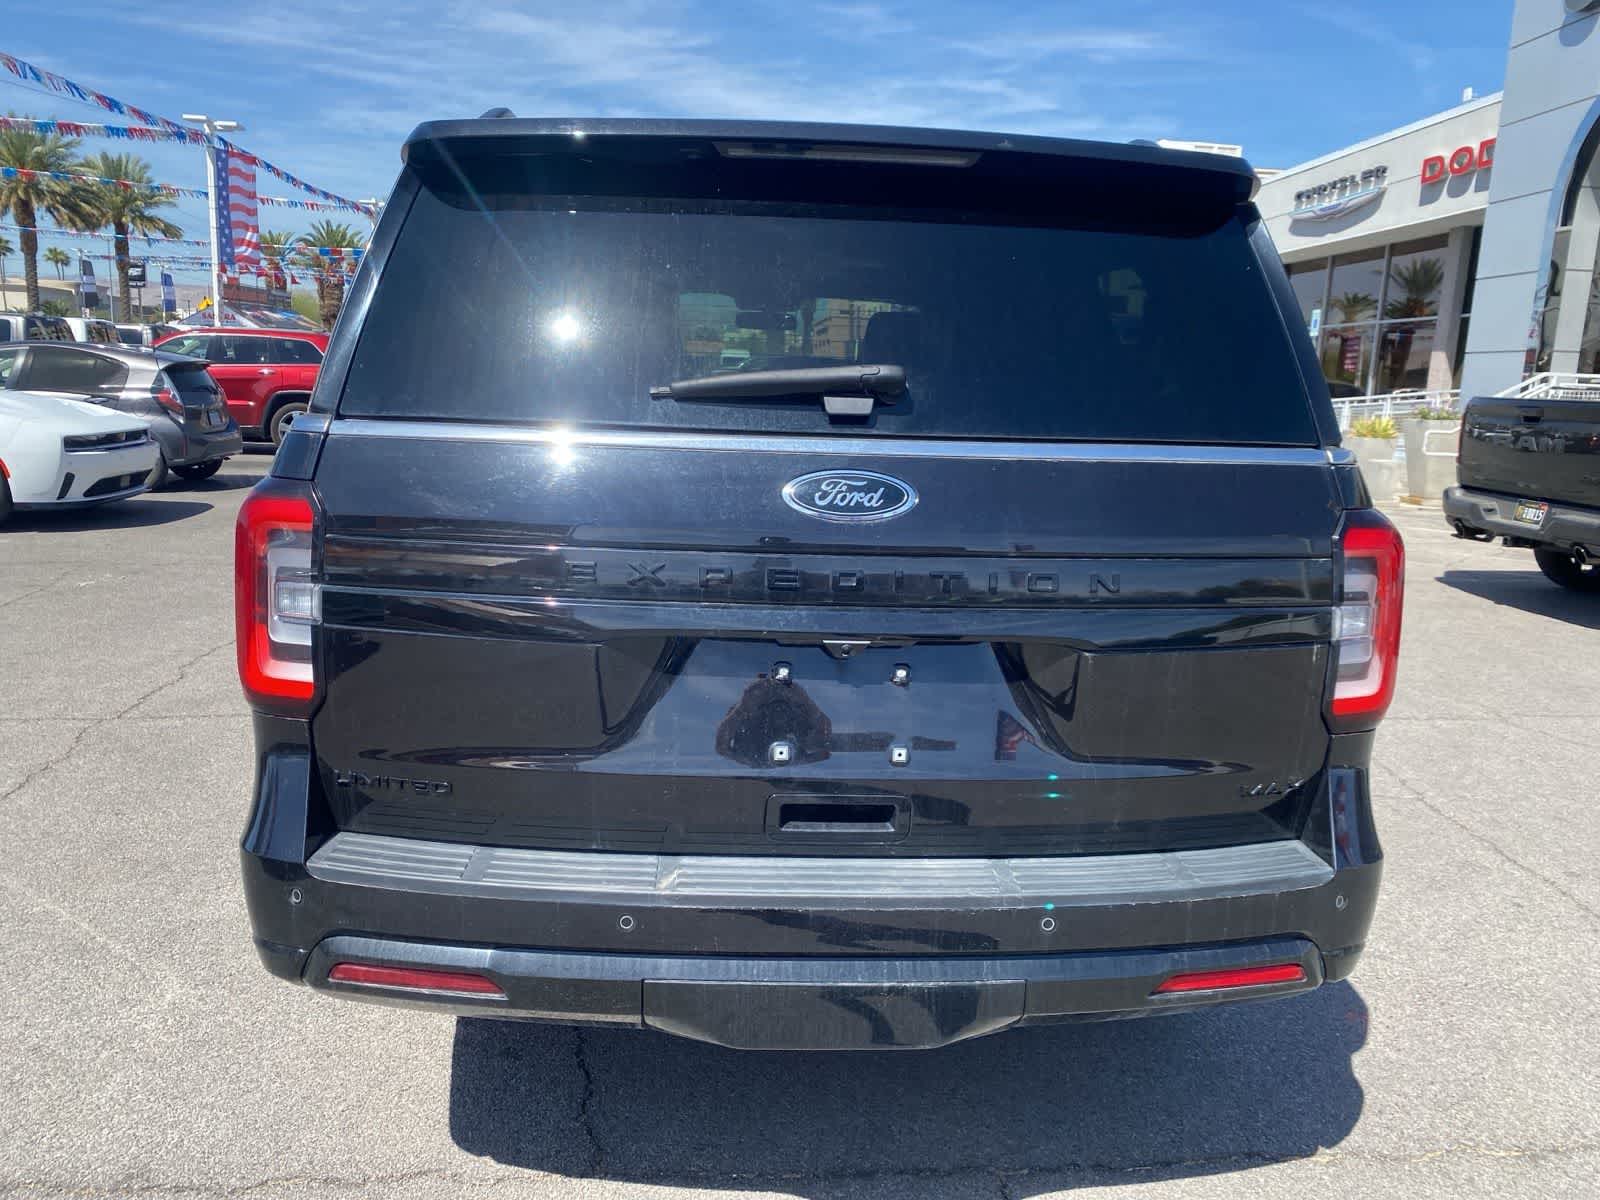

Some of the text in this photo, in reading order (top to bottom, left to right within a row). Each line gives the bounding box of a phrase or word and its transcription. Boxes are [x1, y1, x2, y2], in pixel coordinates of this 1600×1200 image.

[1494, 434, 1566, 454] RAM
[814, 479, 884, 507] Ford
[565, 560, 1121, 595] EXPEDITION
